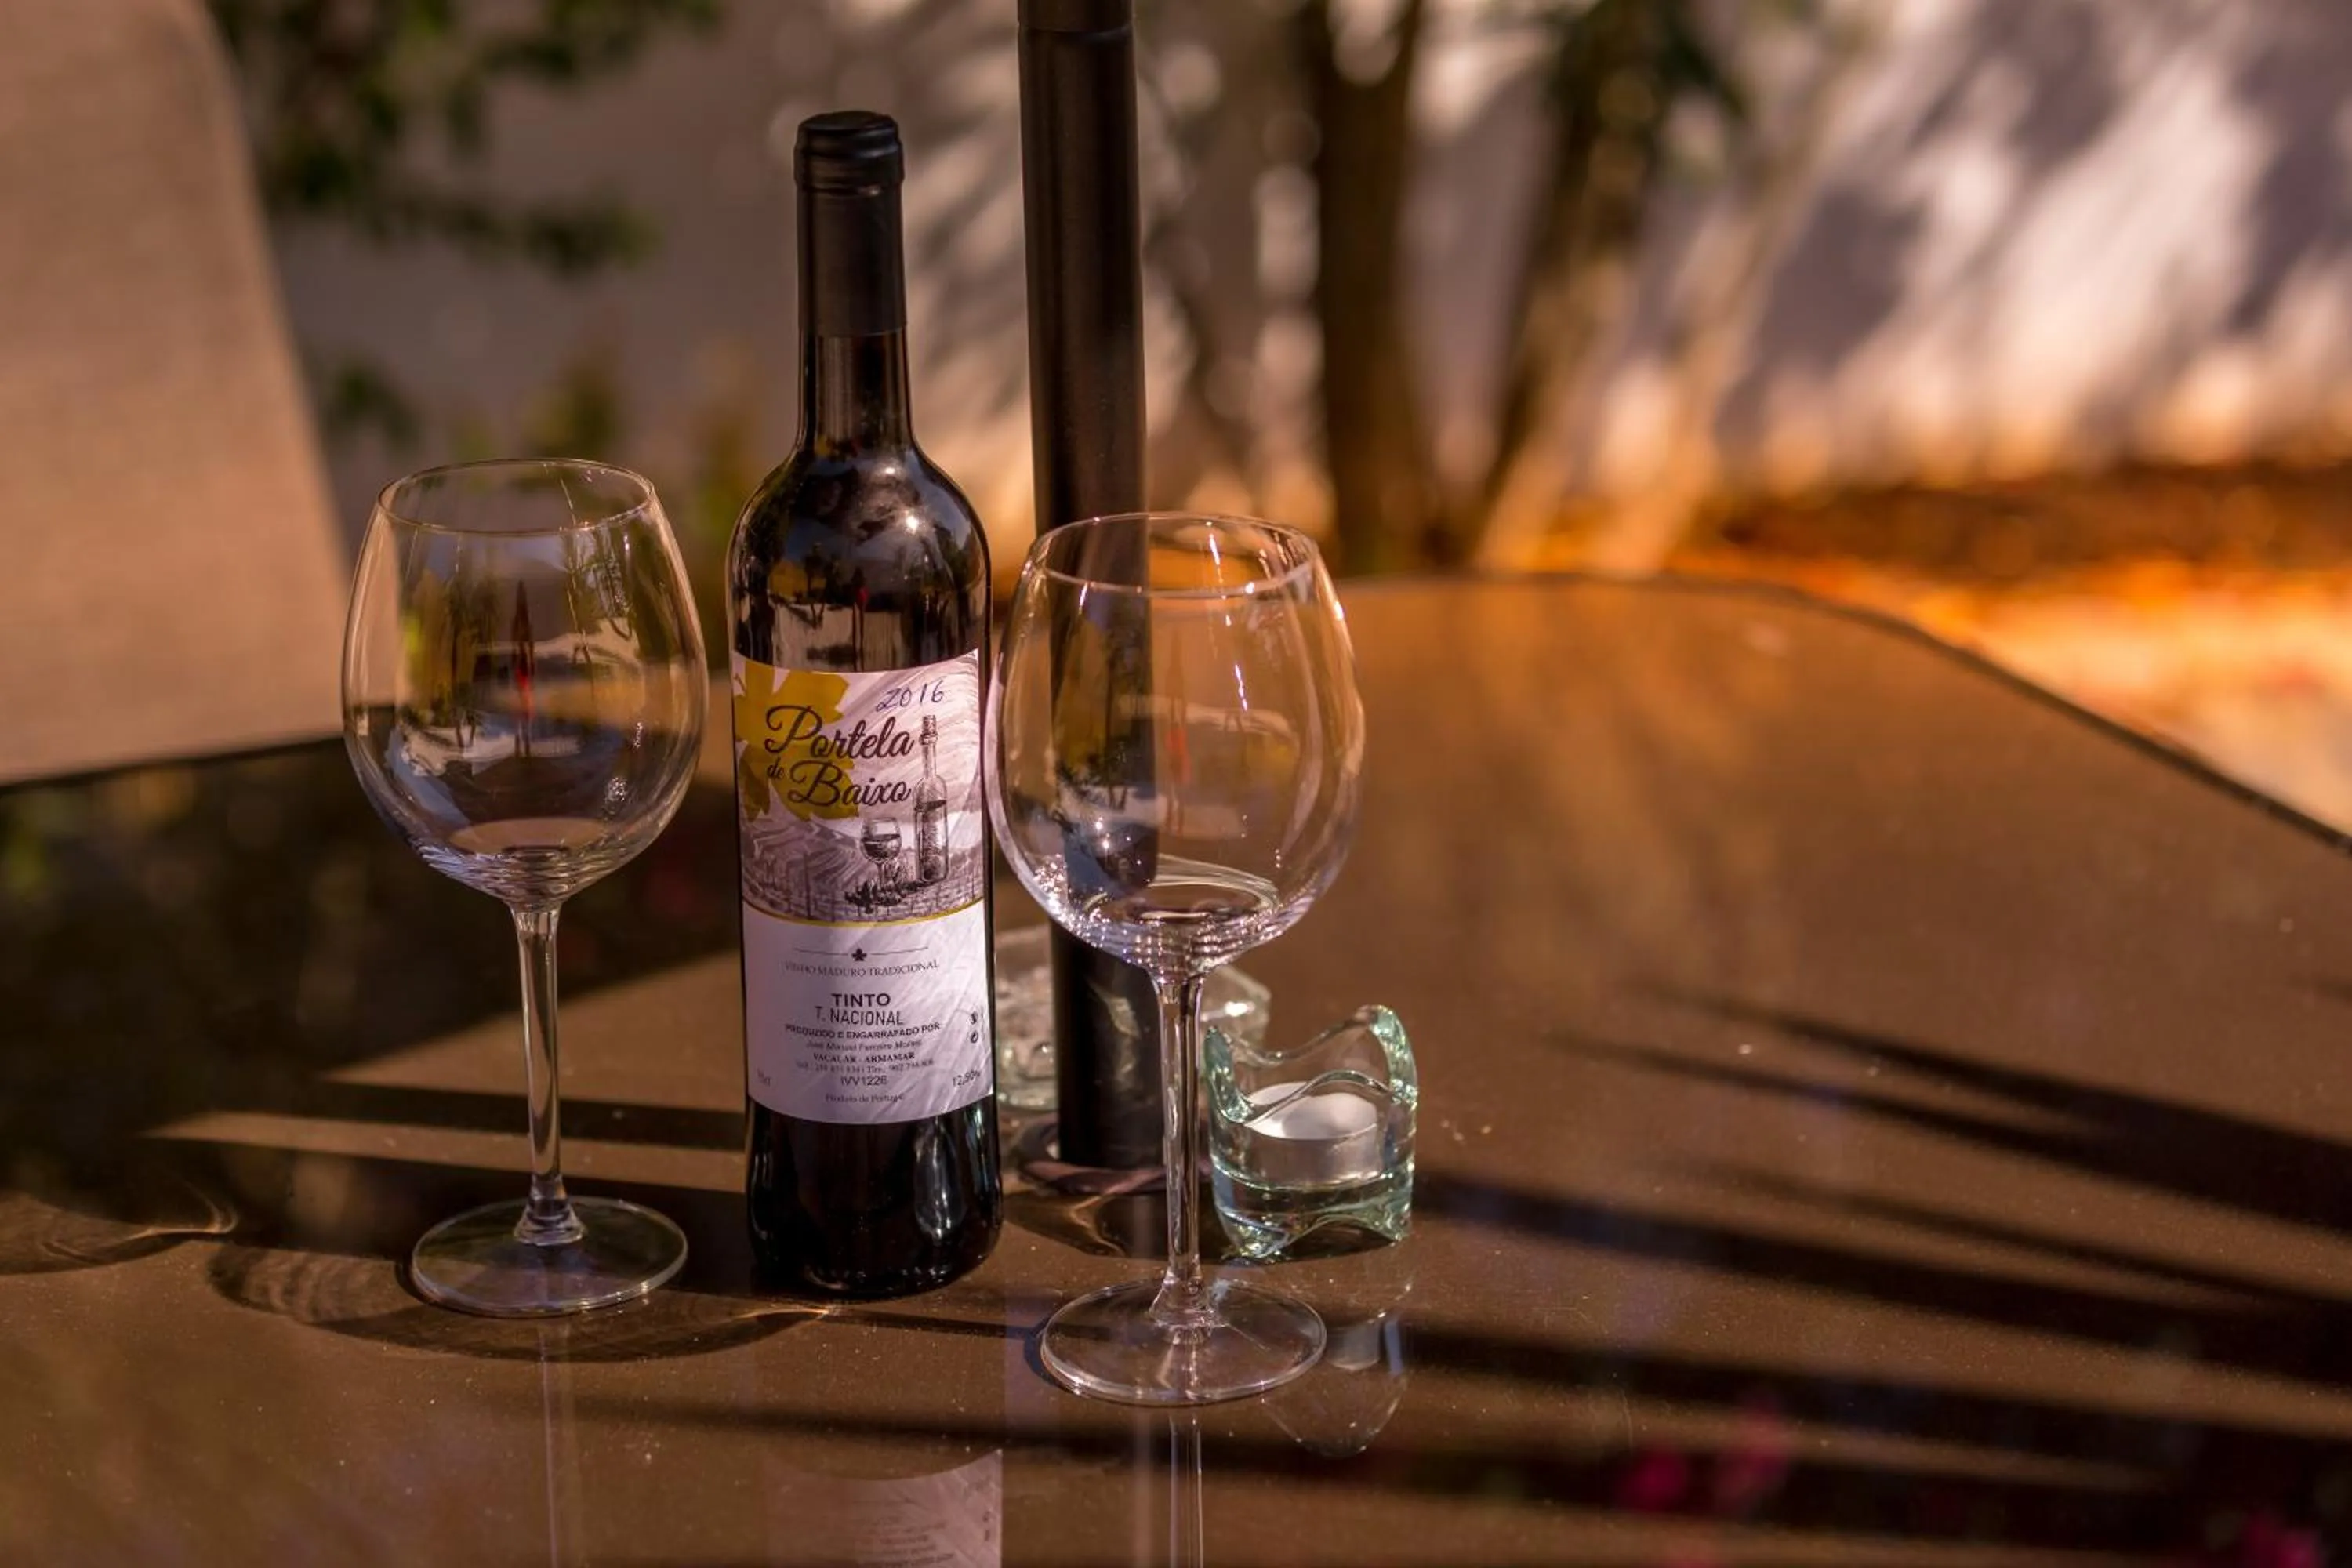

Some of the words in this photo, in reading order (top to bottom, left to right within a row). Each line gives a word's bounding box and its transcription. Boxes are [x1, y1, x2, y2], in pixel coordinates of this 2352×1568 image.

[875, 679, 944, 712] 2016
[764, 705, 915, 759] Portela
[767, 757, 785, 779] de
[787, 760, 911, 807] Baixo
[785, 964, 817, 975] VINHO
[817, 966, 866, 978] MADURO
[869, 959, 940, 977] TRADICIONAL
[831, 993, 891, 1007] TINTO
[815, 1006, 826, 1021] T.
[829, 1008, 903, 1026] NACIONAL
[786, 1023, 835, 1038] PRODUZIDO
[847, 1026, 920, 1039] ENGARRAFADO
[921, 1022, 940, 1033] POR
